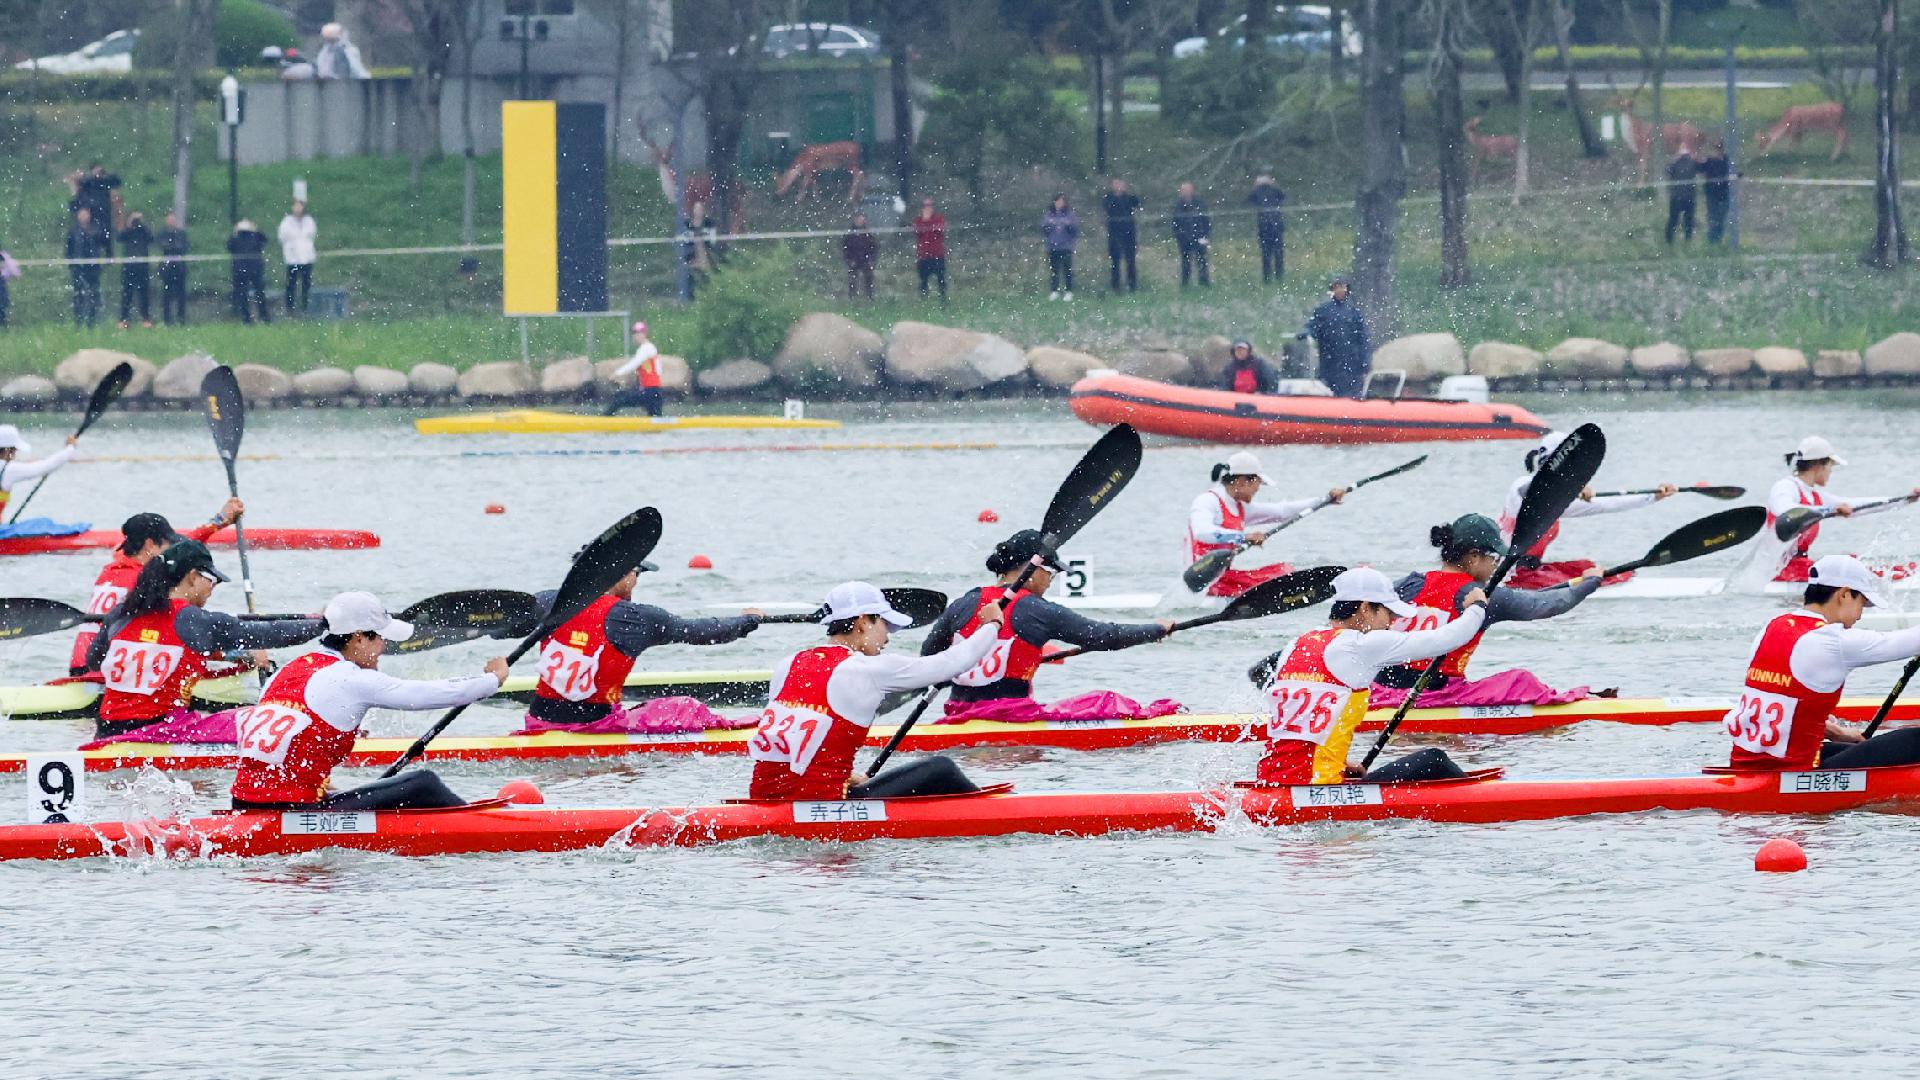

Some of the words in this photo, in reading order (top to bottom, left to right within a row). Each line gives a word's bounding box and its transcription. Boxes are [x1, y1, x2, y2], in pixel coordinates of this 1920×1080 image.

[1066, 560, 1087, 590] 5
[110, 647, 173, 689] 319
[1271, 687, 1338, 734] 326
[1727, 693, 1784, 748] 333
[753, 708, 819, 764] 331
[38, 761, 75, 813] 9
[1309, 785, 1366, 805] 杨凤艳
[1796, 772, 1851, 792] 白晓梅
